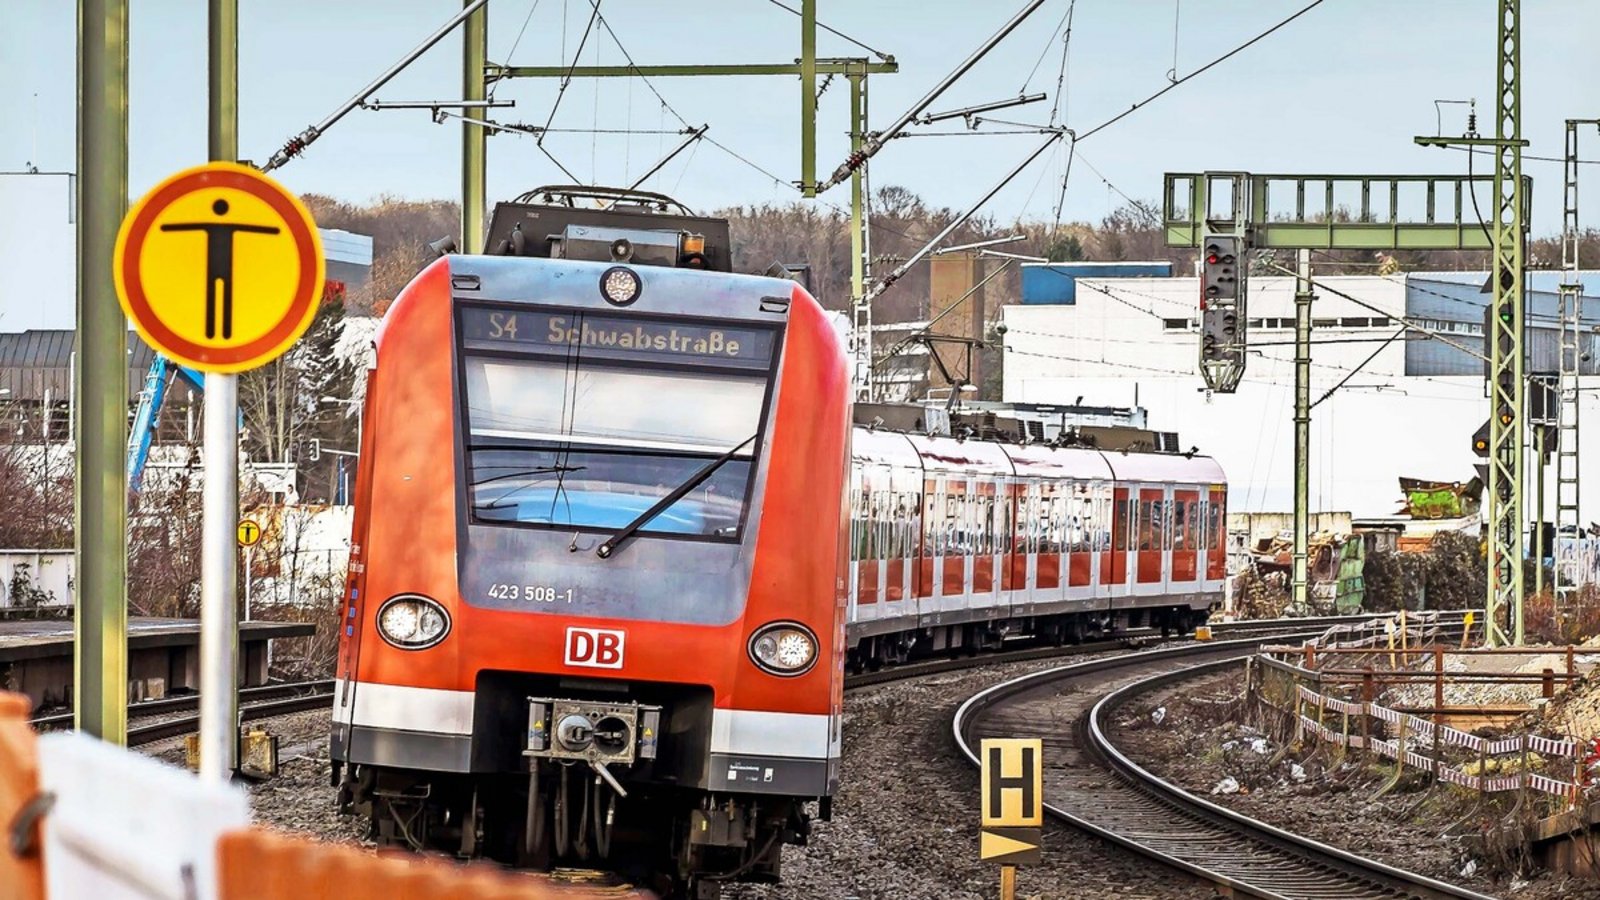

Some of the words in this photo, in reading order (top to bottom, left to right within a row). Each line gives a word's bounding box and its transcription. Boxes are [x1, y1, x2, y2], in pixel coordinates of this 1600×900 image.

[489, 313, 517, 339] S4
[548, 315, 740, 355] Schwabstraße
[488, 583, 519, 600] 423
[524, 586, 573, 604] 508-1
[569, 630, 620, 665] DB
[989, 747, 1034, 818] H
